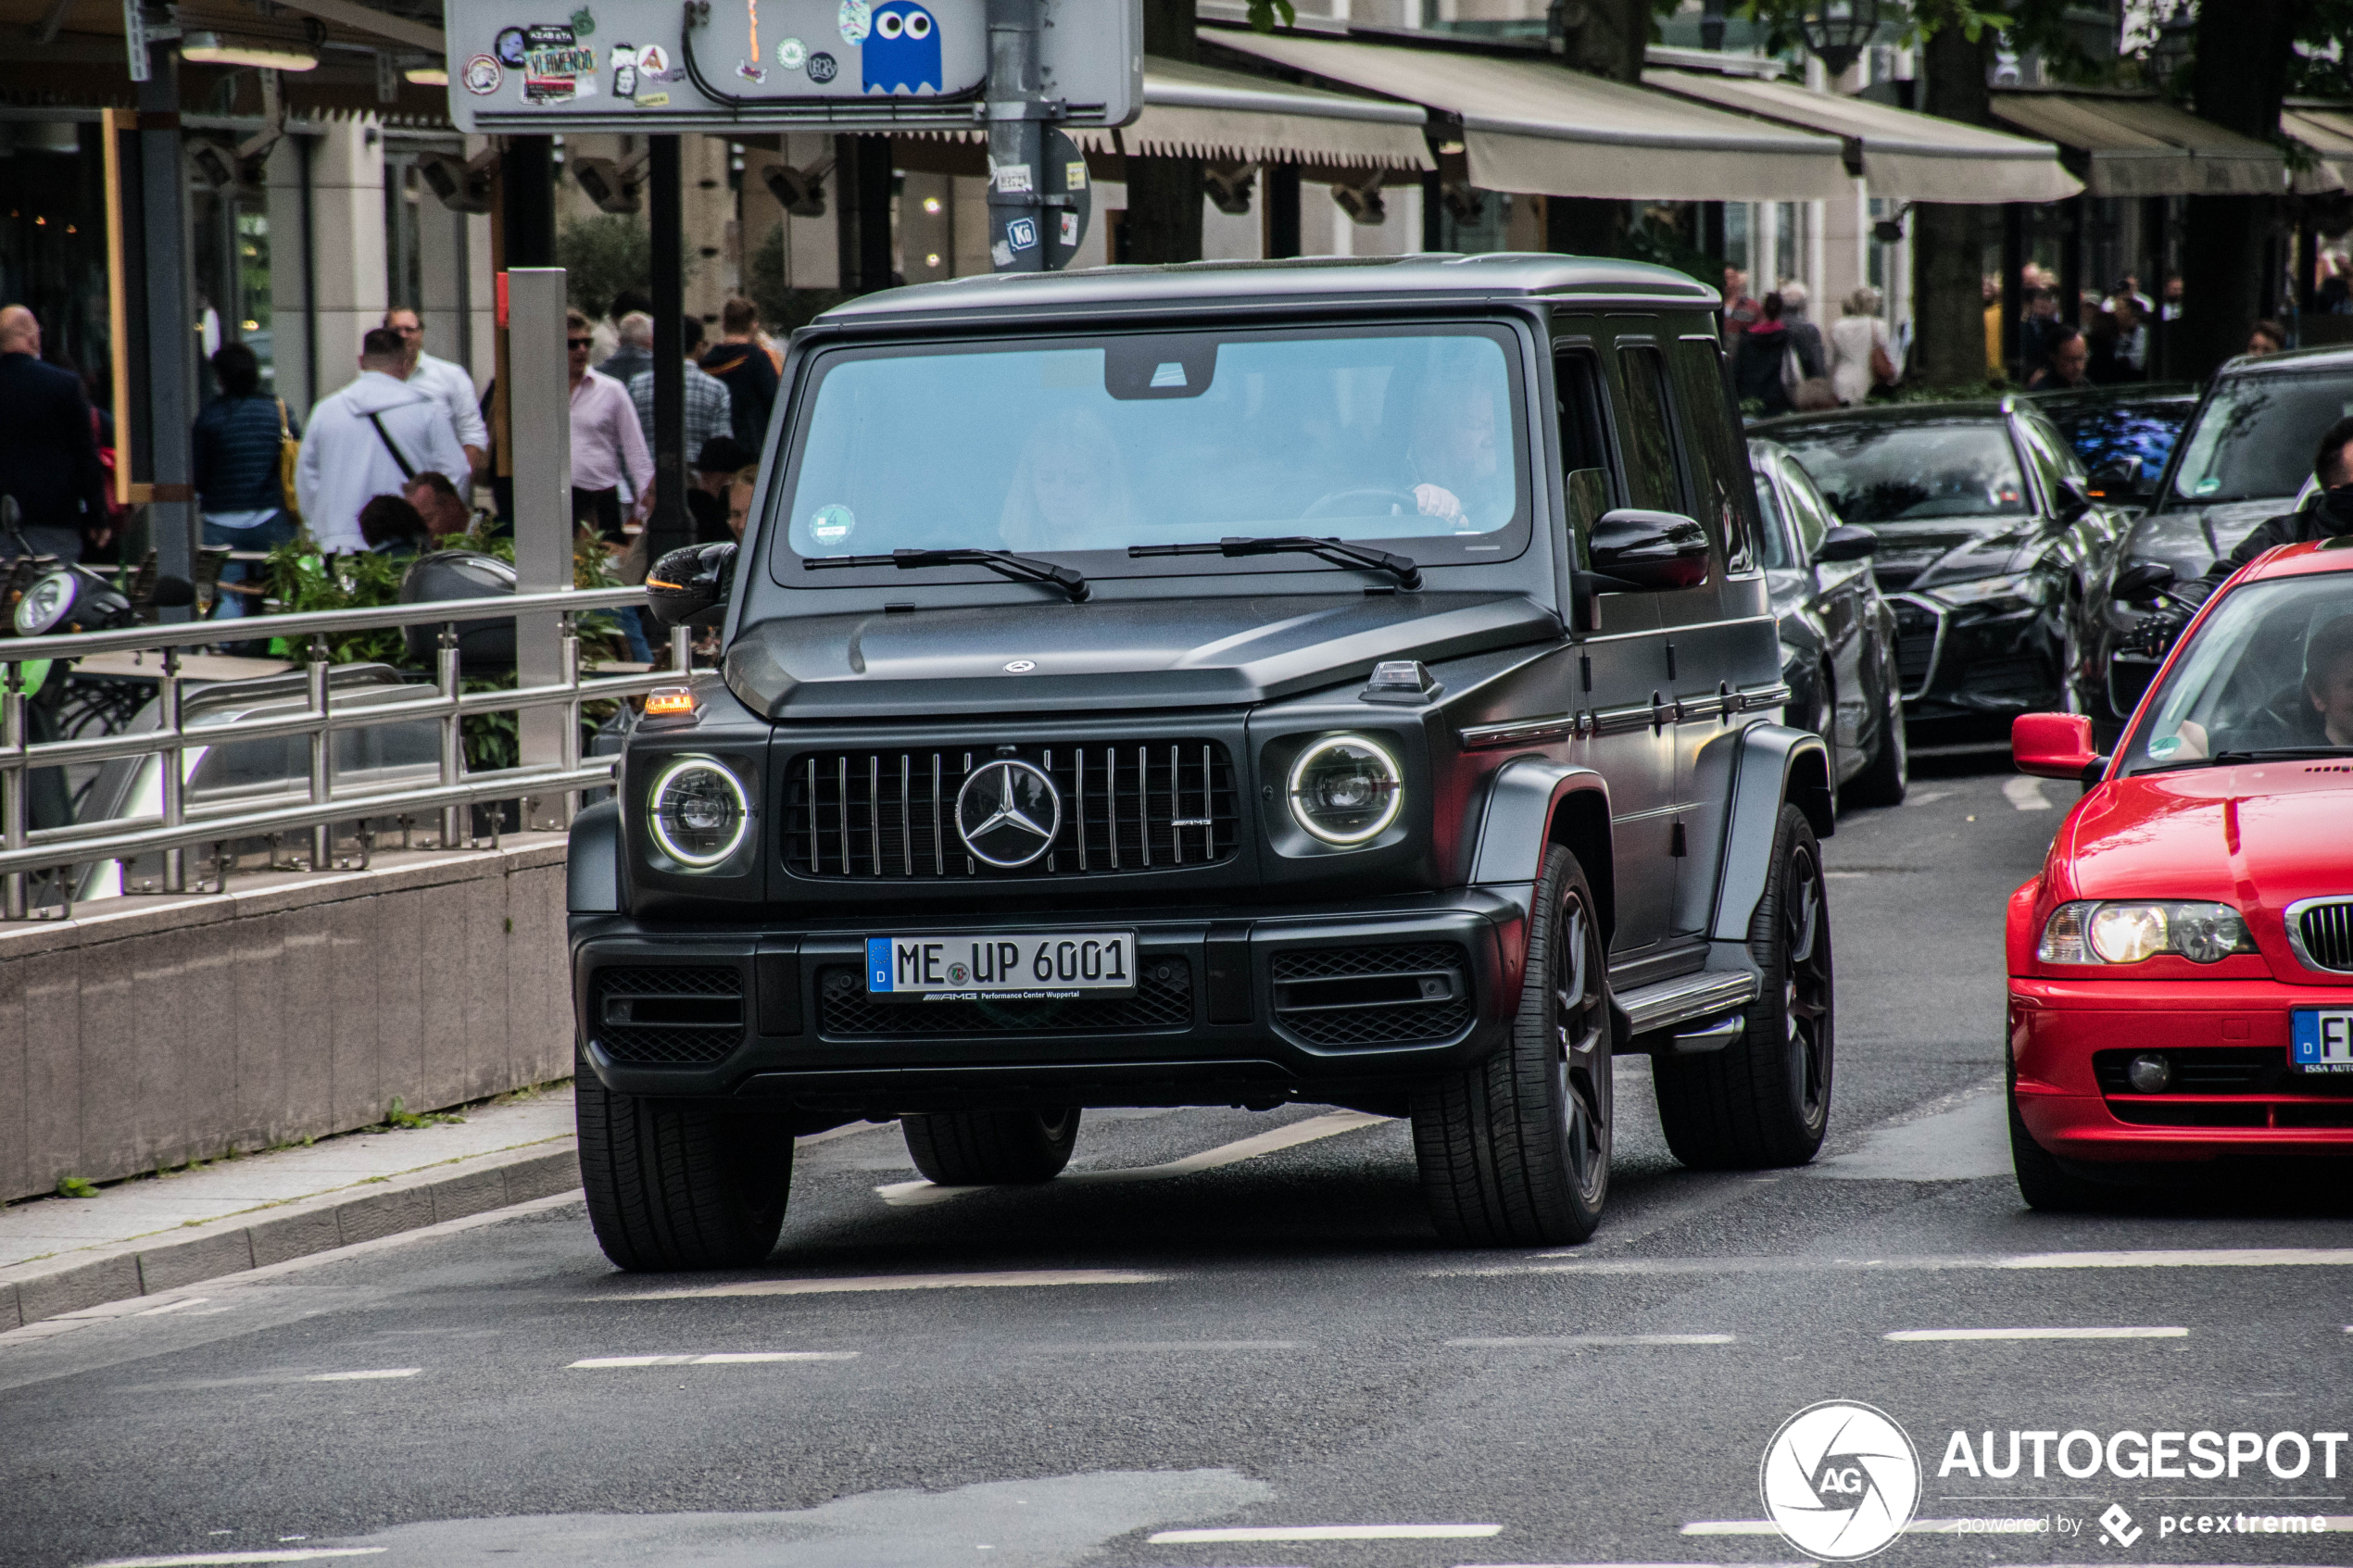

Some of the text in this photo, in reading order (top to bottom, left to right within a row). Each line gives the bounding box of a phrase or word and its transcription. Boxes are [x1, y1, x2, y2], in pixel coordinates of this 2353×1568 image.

[1013, 224, 1033, 245] Kö
[897, 943, 945, 985] ME
[973, 941, 1019, 984] UP
[1033, 938, 1126, 983] 6001
[876, 971, 886, 983] D
[981, 992, 1022, 1000] Performance
[1023, 991, 1046, 999] Center
[1046, 990, 1080, 999] Wuppertal
[2322, 1017, 2353, 1058] F
[2303, 1042, 2313, 1055] D
[2305, 1064, 2328, 1073] ISSA
